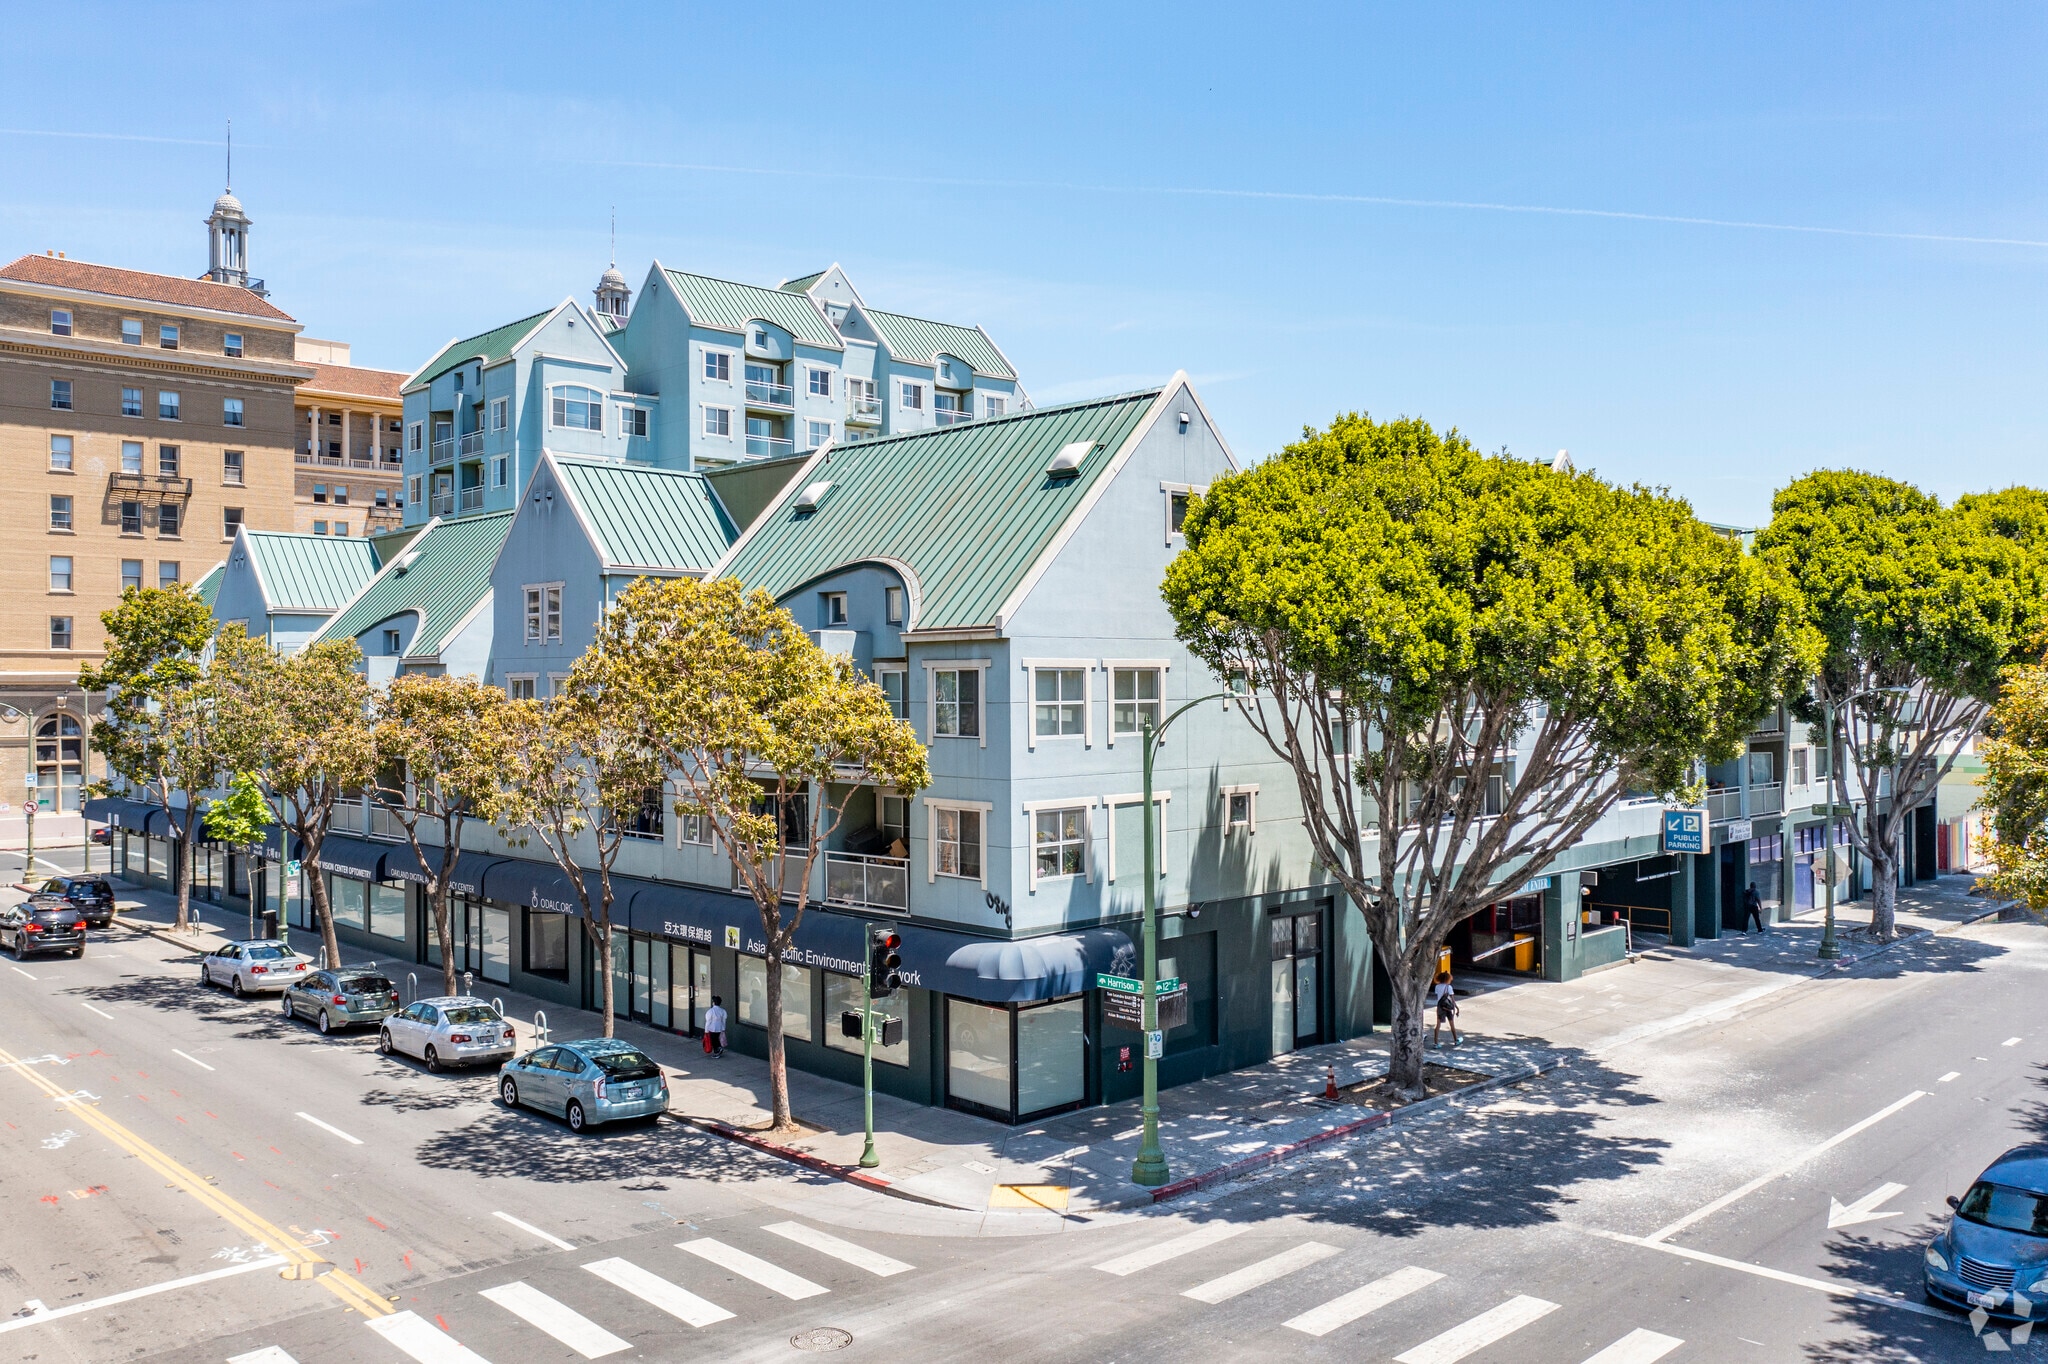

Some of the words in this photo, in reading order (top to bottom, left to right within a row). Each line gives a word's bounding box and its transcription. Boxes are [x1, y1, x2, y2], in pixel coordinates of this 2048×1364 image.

[1668, 841, 1700, 850] PARKING
[1673, 834, 1700, 842] PUBLIC
[322, 861, 334, 870] VISION
[334, 864, 348, 874] CENTER
[348, 867, 372, 879] OPTOMETRY
[390, 868, 409, 880] OAKLAND
[409, 872, 425, 883] DIGITAL
[458, 883, 475, 893] CENTER
[1531, 878, 1548, 891] ENTER
[540, 898, 574, 914] ODALC.ORG
[664, 921, 712, 943] 亞太環保網絡
[747, 938, 767, 954] Asia
[780, 946, 803, 962] acific
[805, 949, 870, 975] Environment
[1107, 978, 1135, 991] Harrison
